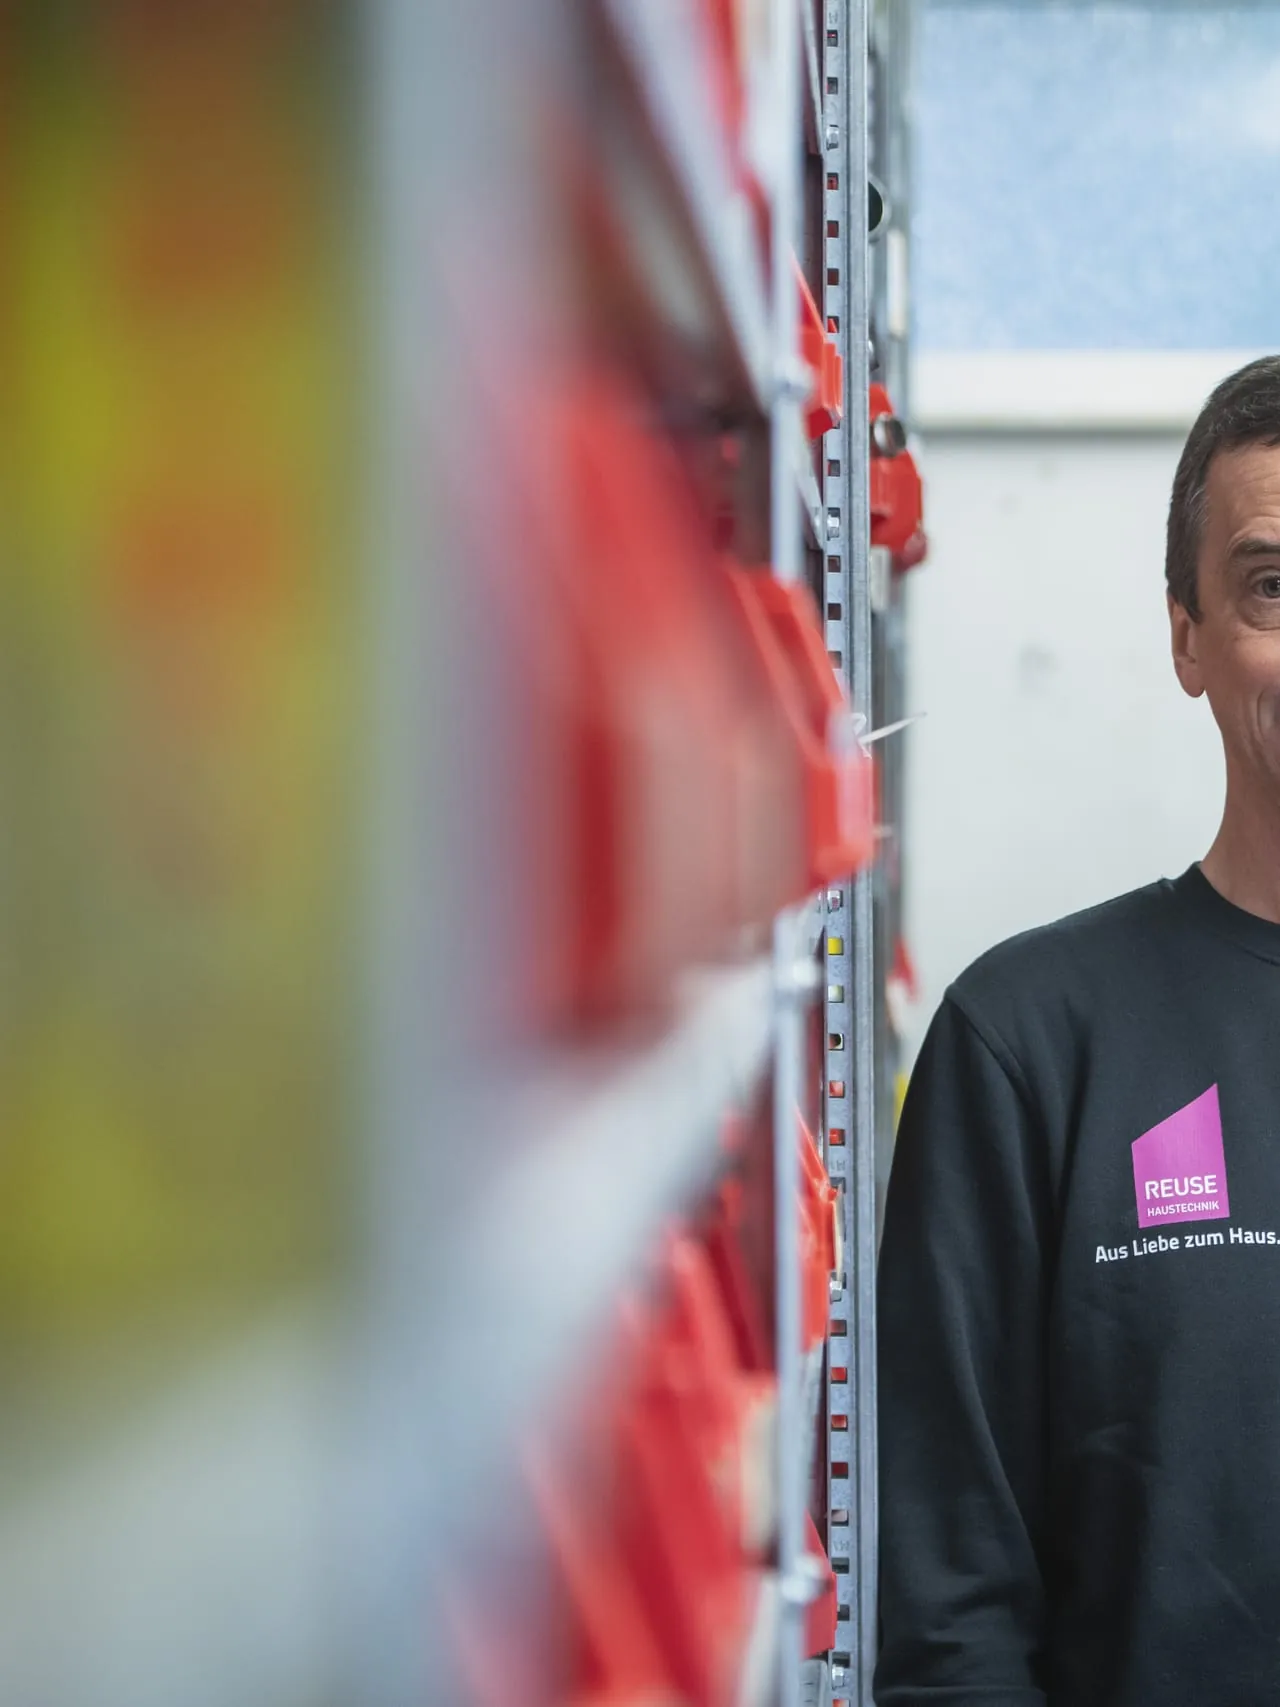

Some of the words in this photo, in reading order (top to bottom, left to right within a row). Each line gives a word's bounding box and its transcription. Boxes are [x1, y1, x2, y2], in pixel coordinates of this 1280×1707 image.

[1144, 1174, 1218, 1200] REUSE
[1147, 1200, 1220, 1217] HAUSTECHNIK
[1095, 1245, 1128, 1263] Aus
[1132, 1235, 1180, 1256] Liebe
[1184, 1229, 1224, 1248] zum
[1229, 1227, 1280, 1245] Haus.
